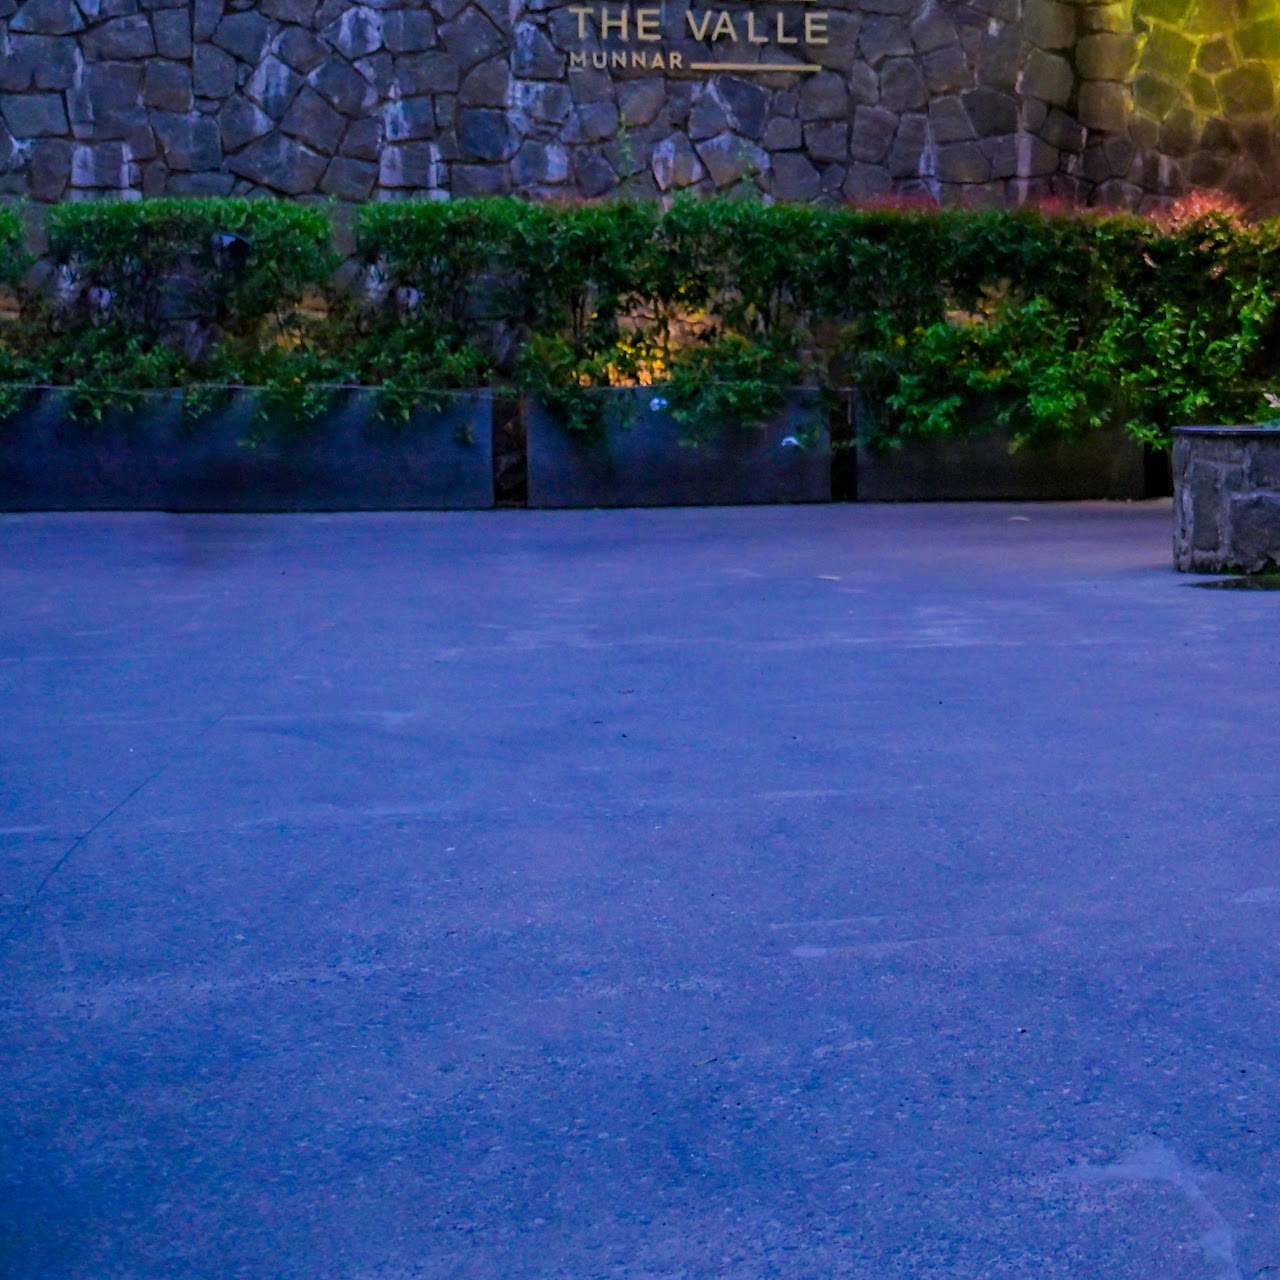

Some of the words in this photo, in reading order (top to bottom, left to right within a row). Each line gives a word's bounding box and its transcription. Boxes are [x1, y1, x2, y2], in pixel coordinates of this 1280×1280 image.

[568, 7, 662, 41] THE
[685, 9, 829, 44] VALLE
[569, 51, 683, 70] MUNNAR
